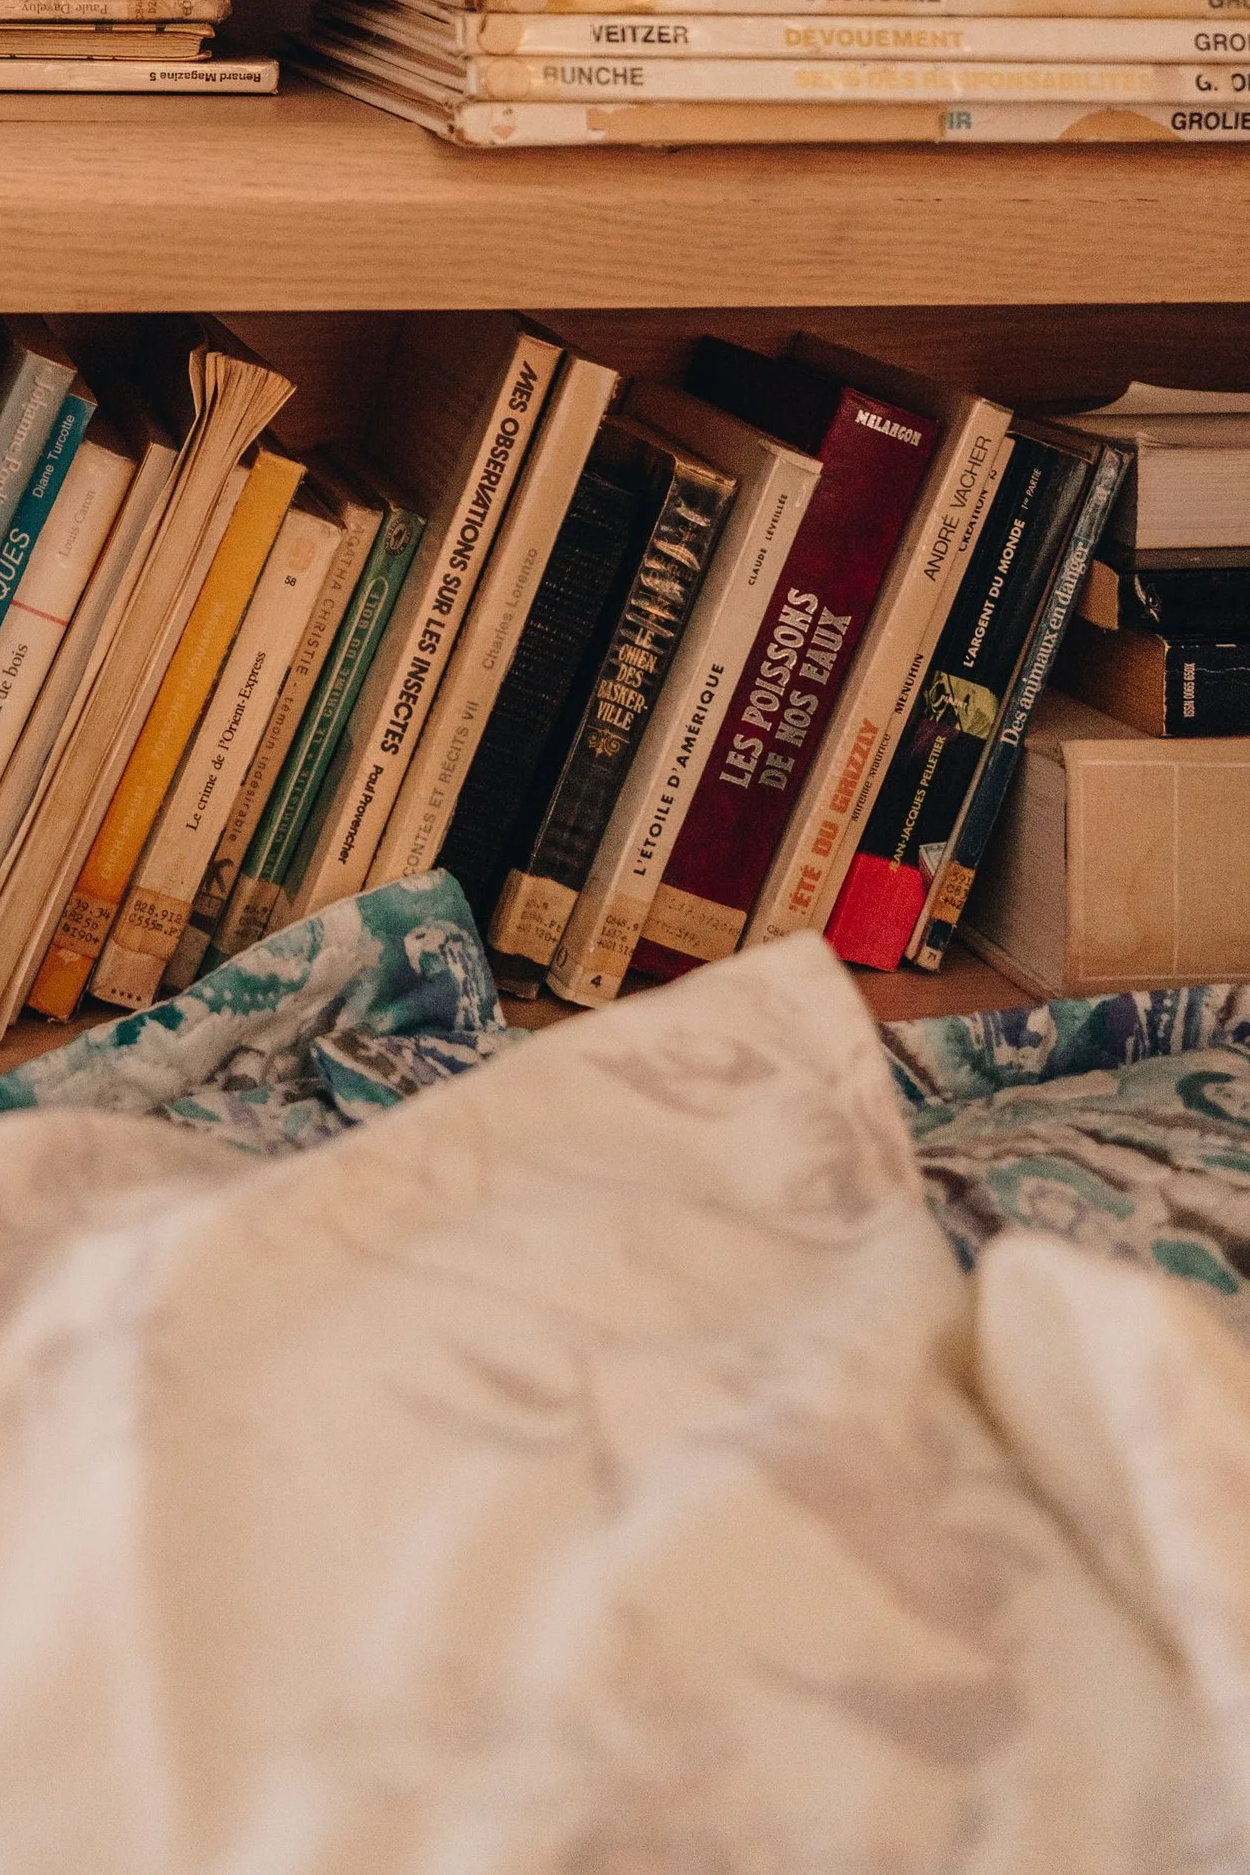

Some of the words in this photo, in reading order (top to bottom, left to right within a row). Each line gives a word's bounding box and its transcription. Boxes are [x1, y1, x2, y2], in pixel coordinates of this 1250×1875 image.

[160, 71, 217, 84] Magazine
[219, 72, 261, 83] Renard
[10, 373, 53, 454] Johanne
[508, 360, 539, 413] MES
[32, 452, 56, 500] Diane
[47, 413, 76, 454] Turcotte
[448, 416, 520, 573] OBSERVATIONS
[924, 512, 960, 582] ANDRÉ
[950, 434, 993, 510] VACHER
[748, 546, 768, 586] CLAUDE
[764, 493, 790, 542] LÉVEILLÉE
[963, 595, 998, 669] L'ARGENT
[988, 575, 1005, 601] DU
[997, 516, 1028, 578] MONDE
[1025, 466, 1044, 501] PARTIE
[285, 574, 298, 589] 58
[430, 572, 462, 617] SUR
[1055, 539, 1092, 605] danger
[296, 598, 336, 678] CHRISTIE
[416, 616, 447, 657] LES
[482, 610, 514, 671] Charles
[506, 547, 538, 610] Lorenzo
[635, 629, 655, 650] LE
[1049, 602, 1068, 630] en
[6, 643, 30, 684] bois
[615, 663, 645, 687] DES
[618, 646, 658, 674] CHIEN
[798, 606, 853, 687] EAUX
[1019, 627, 1060, 713] animaux
[264, 690, 297, 750] témoin
[381, 655, 432, 757] INSECTES
[595, 701, 635, 733] VILLE
[596, 679, 649, 713] BASKER-
[719, 732, 764, 791] LES
[742, 588, 820, 732] POISSONS
[776, 687, 820, 750] NOS
[1183, 700, 1196, 718] ISSN
[186, 809, 202, 832] Le
[196, 769, 219, 813] crime
[213, 748, 226, 772] de
[221, 650, 267, 753] l'Orient-Express
[999, 709, 1029, 749] Des
[228, 751, 269, 844] indésirable
[367, 763, 385, 792] Paul
[429, 785, 445, 810] ET
[439, 724, 470, 784] RÉCITS
[633, 792, 675, 877] L'ÉTOILE
[668, 663, 726, 790] D'AMÉRIQUE
[758, 751, 797, 793] DE
[811, 819, 840, 859] DU
[829, 716, 881, 815] GRIZZLY
[338, 784, 375, 865] Provencher
[888, 788, 927, 875] JEAN-JACQUES
[919, 733, 948, 789] PELLETIER
[589, 973, 603, 988] 4
